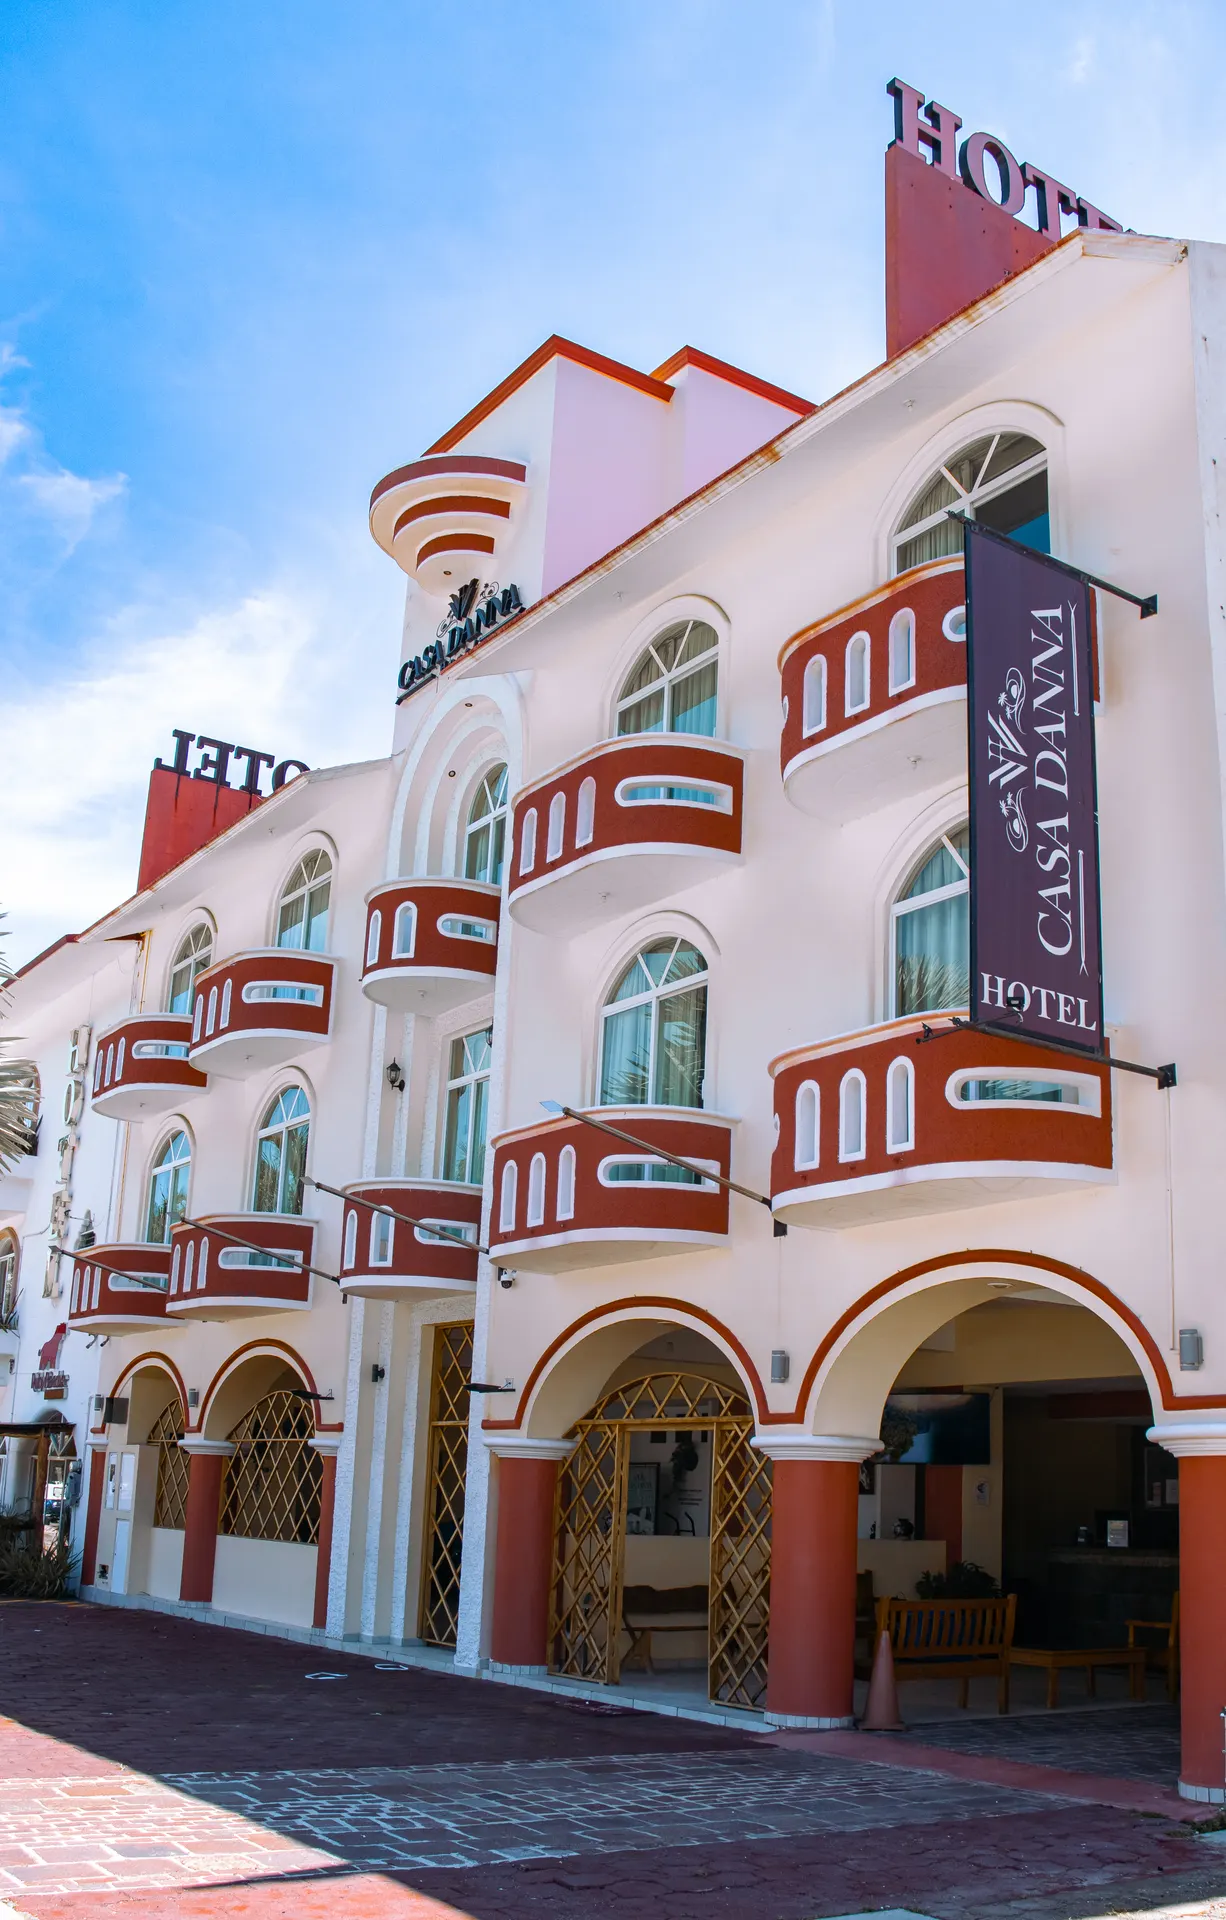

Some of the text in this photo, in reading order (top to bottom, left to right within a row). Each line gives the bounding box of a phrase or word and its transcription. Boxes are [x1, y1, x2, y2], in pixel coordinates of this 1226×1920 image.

[887, 77, 1137, 243] HOT
[398, 640, 447, 690] CASA
[446, 583, 523, 657] DANNA
[1030, 604, 1073, 956] CASA DANNA
[981, 972, 1097, 1032] HOTEL
